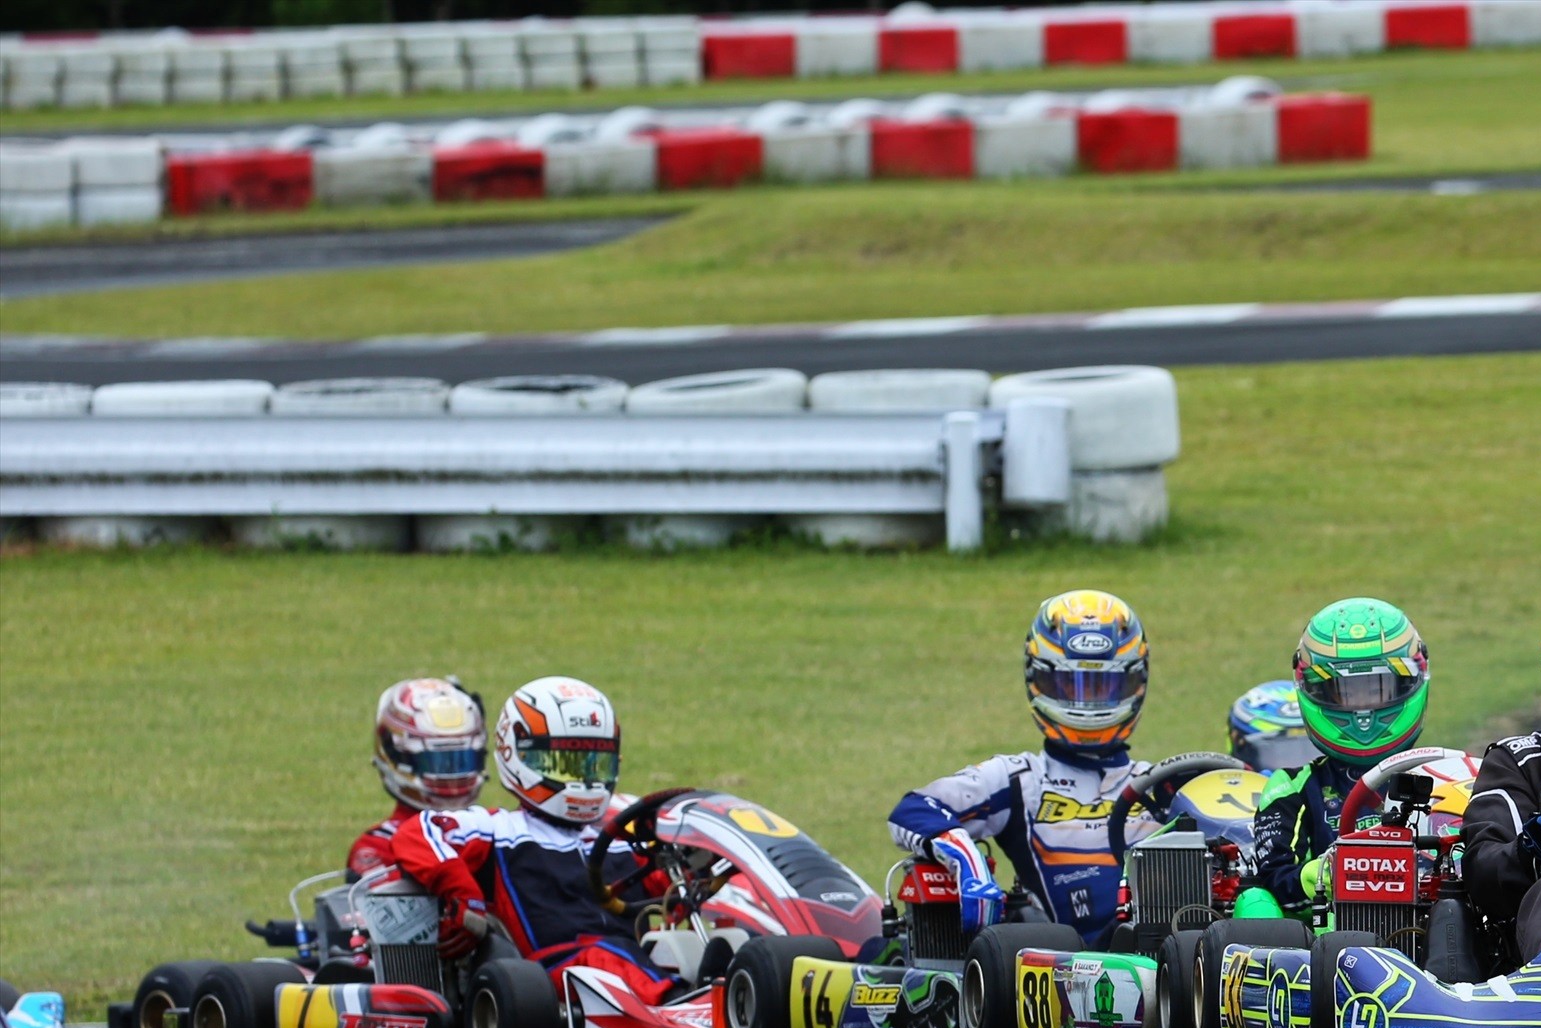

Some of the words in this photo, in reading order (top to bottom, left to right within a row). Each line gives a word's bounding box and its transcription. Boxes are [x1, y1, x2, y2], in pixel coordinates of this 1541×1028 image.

[550, 738, 616, 751] HONDA
[1368, 830, 1402, 838] evo
[1343, 858, 1407, 872] ROTAX
[922, 872, 959, 882] ROT
[1345, 881, 1405, 892] evo
